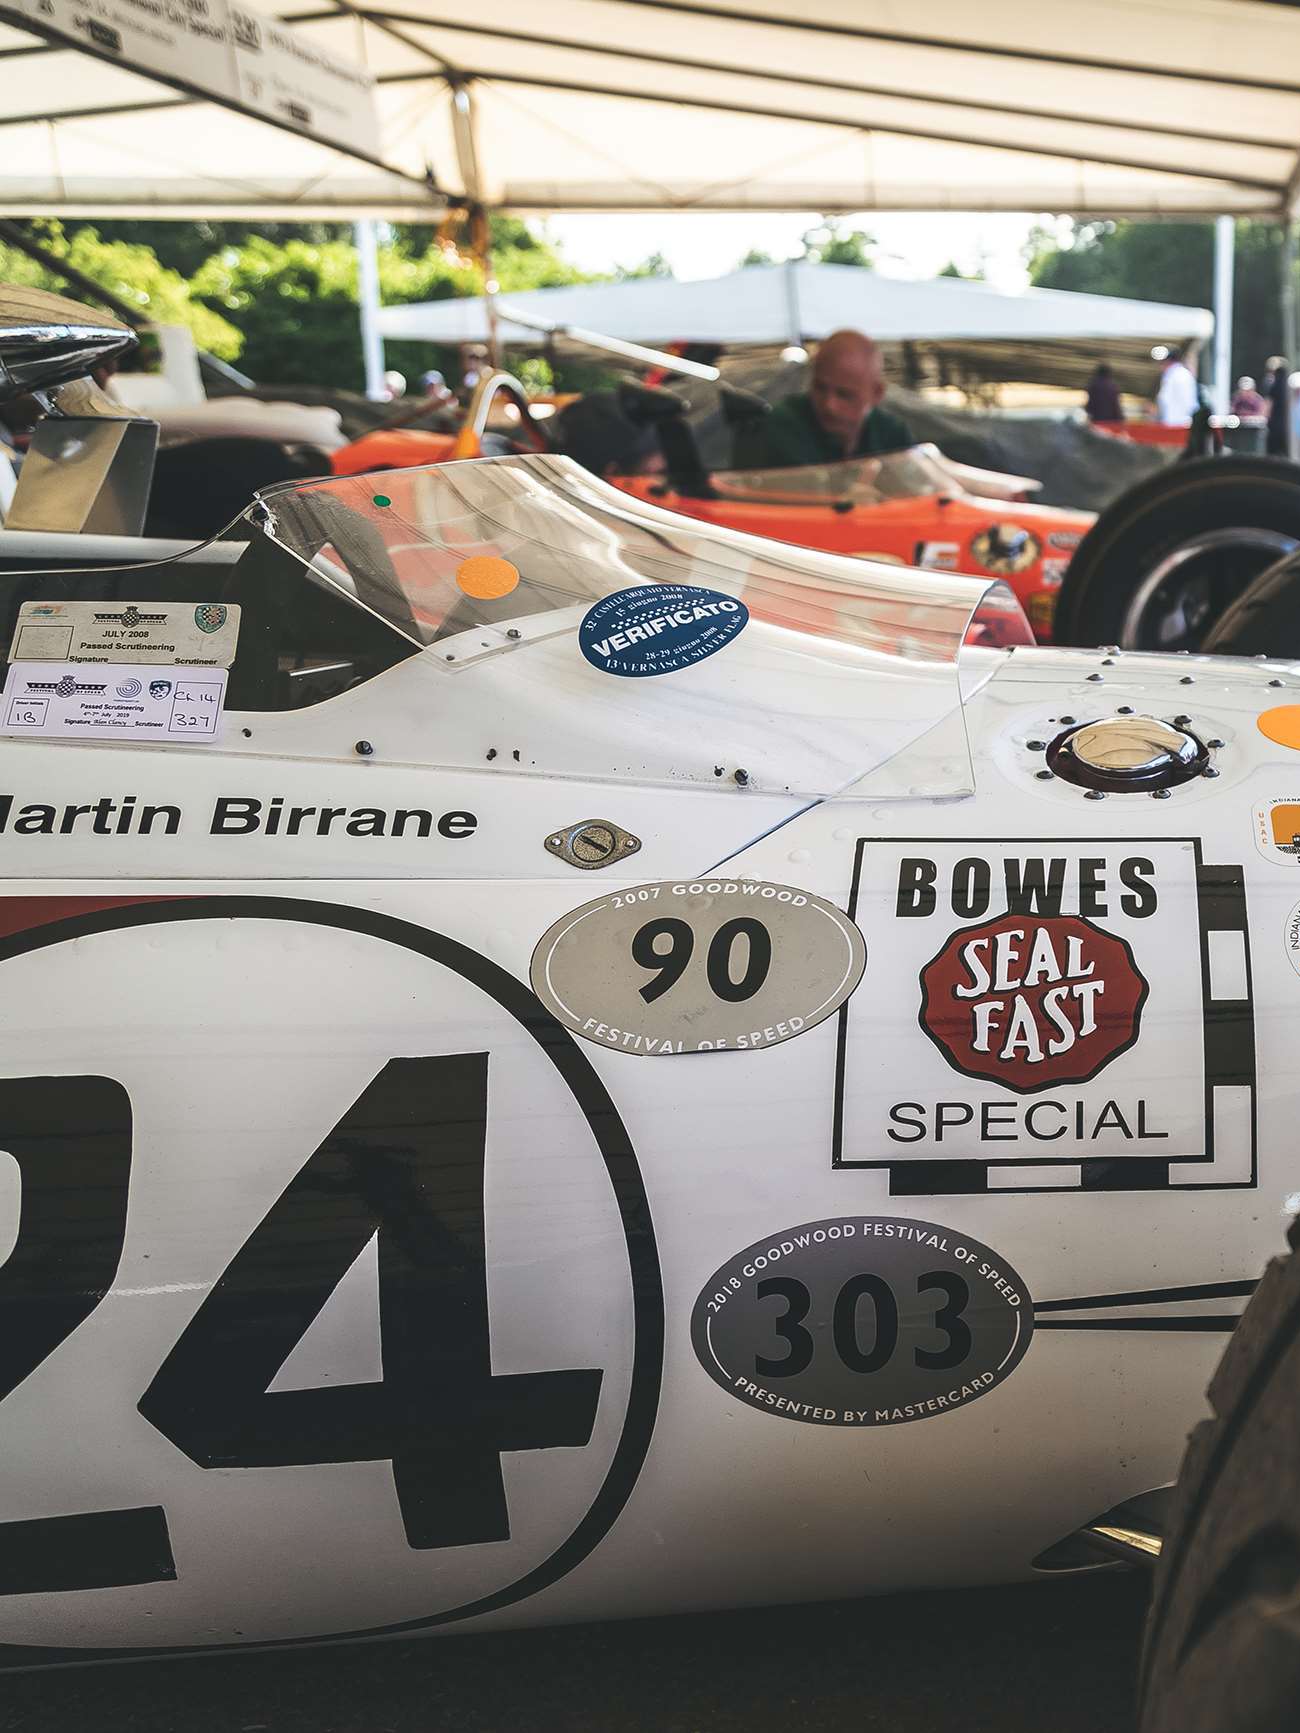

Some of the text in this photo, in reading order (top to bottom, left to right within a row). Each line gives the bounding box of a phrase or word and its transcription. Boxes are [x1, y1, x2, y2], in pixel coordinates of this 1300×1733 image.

[591, 600, 739, 657] VERIFICATO
[615, 607, 626, 617] 15
[80, 642, 175, 652] Passed Scrutineering
[102, 630, 149, 638] JULY 2008
[623, 655, 690, 672] VERNASCA
[691, 633, 727, 659] SILVER
[69, 655, 218, 665] Signature Scrutineer
[645, 649, 671, 660] 28-29
[104, 704, 144, 712] Scrutineering
[175, 713, 209, 727] 327
[209, 796, 478, 839] Birrane
[611, 882, 809, 909] 2007 GOODWOOD
[895, 857, 1158, 919] BOWES
[631, 916, 773, 1005] 90
[956, 926, 1096, 998] SEAL
[581, 1016, 805, 1054] FESTIVAL OF SPEED
[972, 980, 1105, 1063] FAST
[886, 1100, 1169, 1142] SPECIAL
[706, 1223, 1023, 1313] 2018 GOODWOOD FESTIVAL OF SPEED
[754, 1269, 973, 1379] 303
[734, 1370, 995, 1423] PRESENTED BY MASTERCARD
